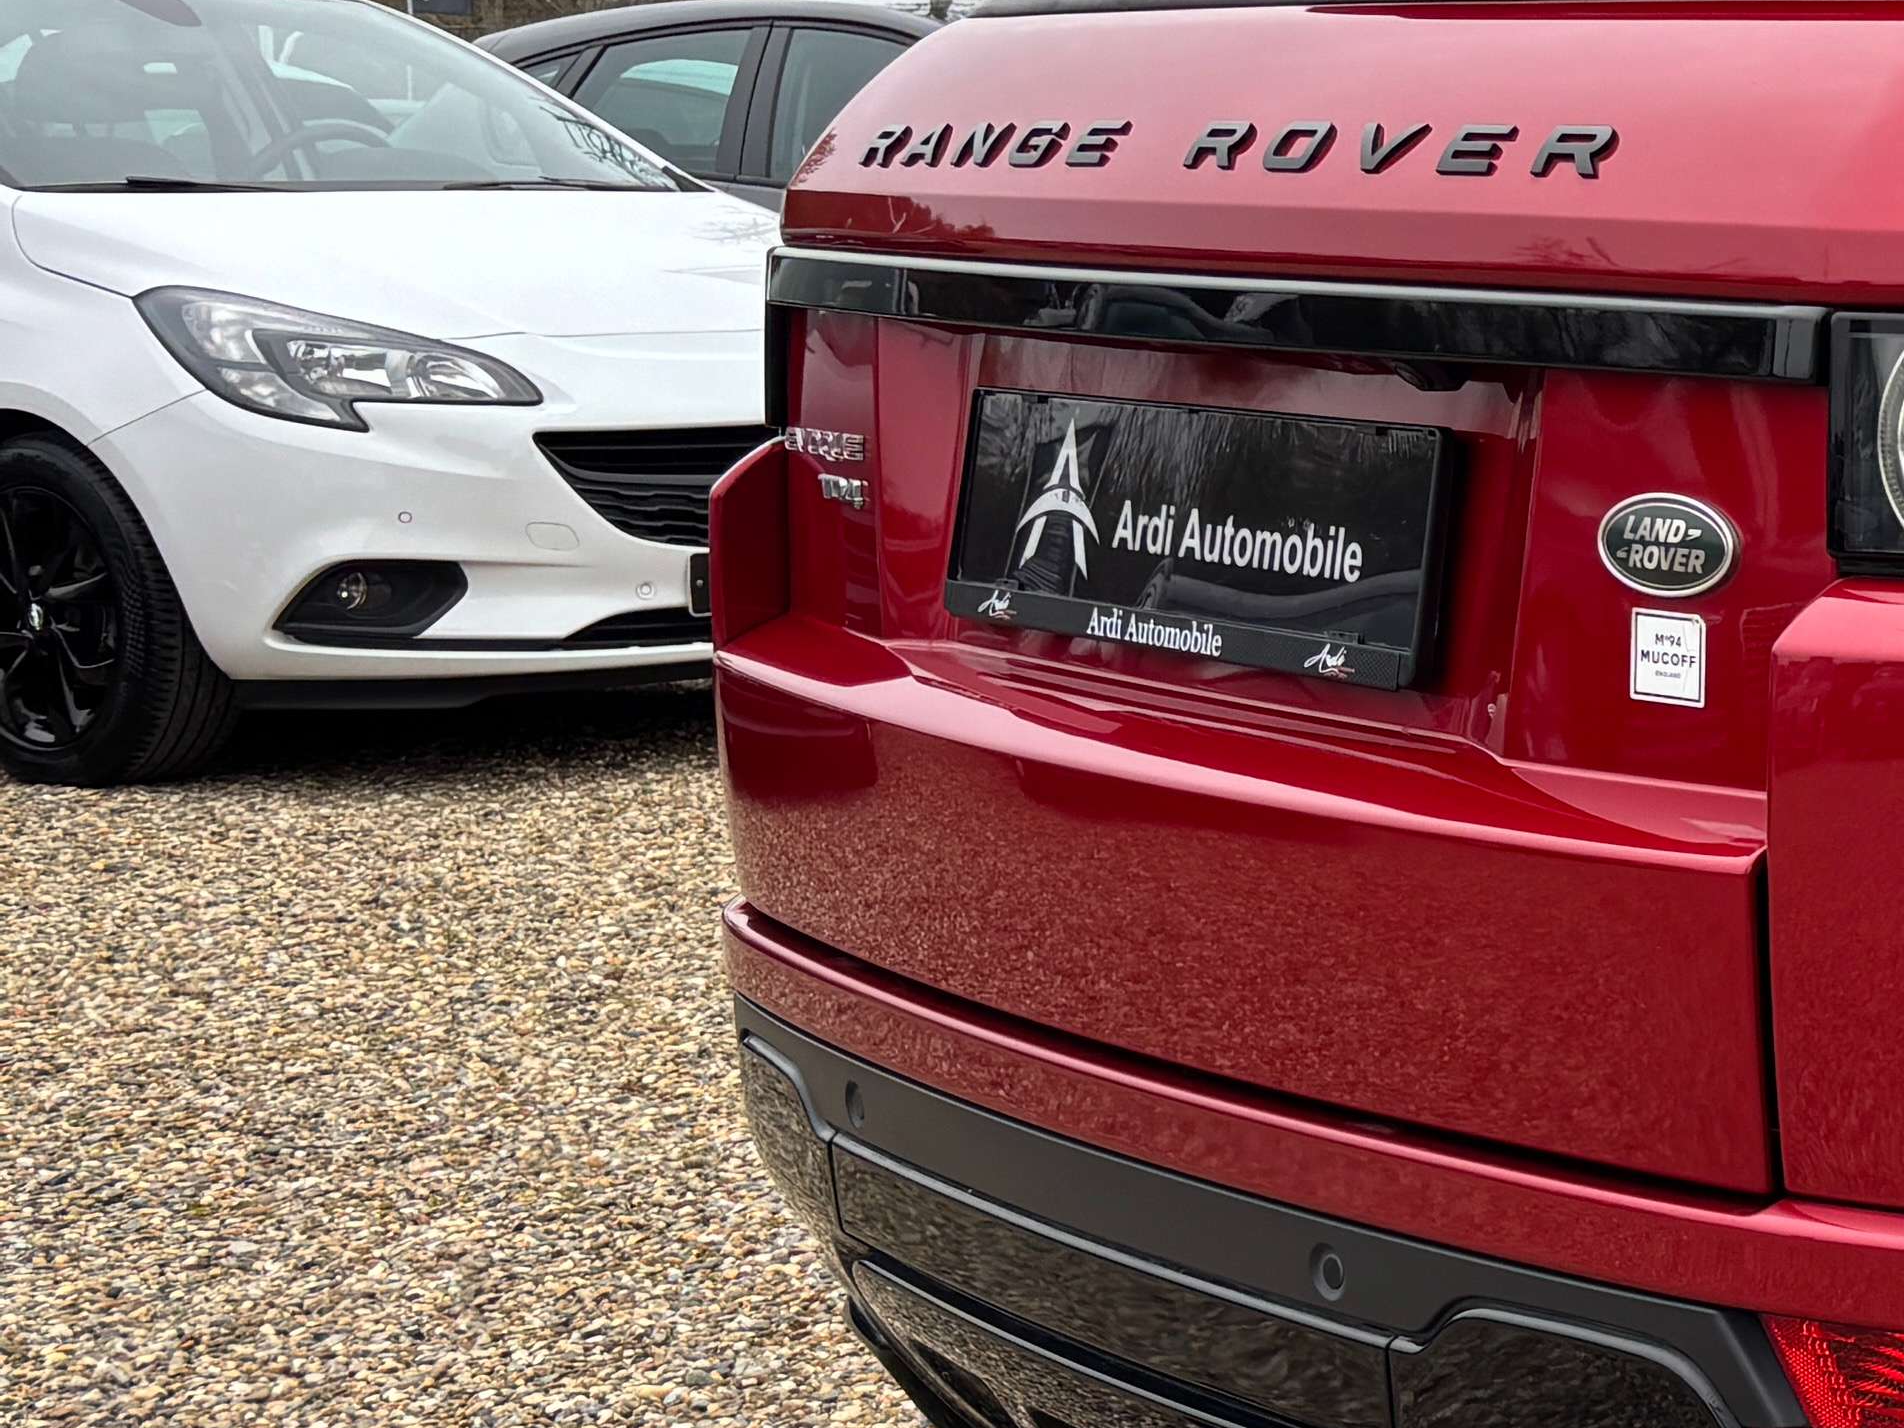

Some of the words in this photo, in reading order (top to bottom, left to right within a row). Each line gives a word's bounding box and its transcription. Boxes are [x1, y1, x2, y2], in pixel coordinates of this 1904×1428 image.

[857, 118, 1134, 170] RANGE
[1182, 119, 1619, 180] ROVER
[1111, 498, 1175, 557] Ardi
[1178, 506, 1363, 583] Automobile
[1623, 514, 1687, 544] LAND
[1628, 543, 1706, 574] ROVER
[1086, 606, 1122, 641] Ardi
[1124, 613, 1223, 658] Automobile
